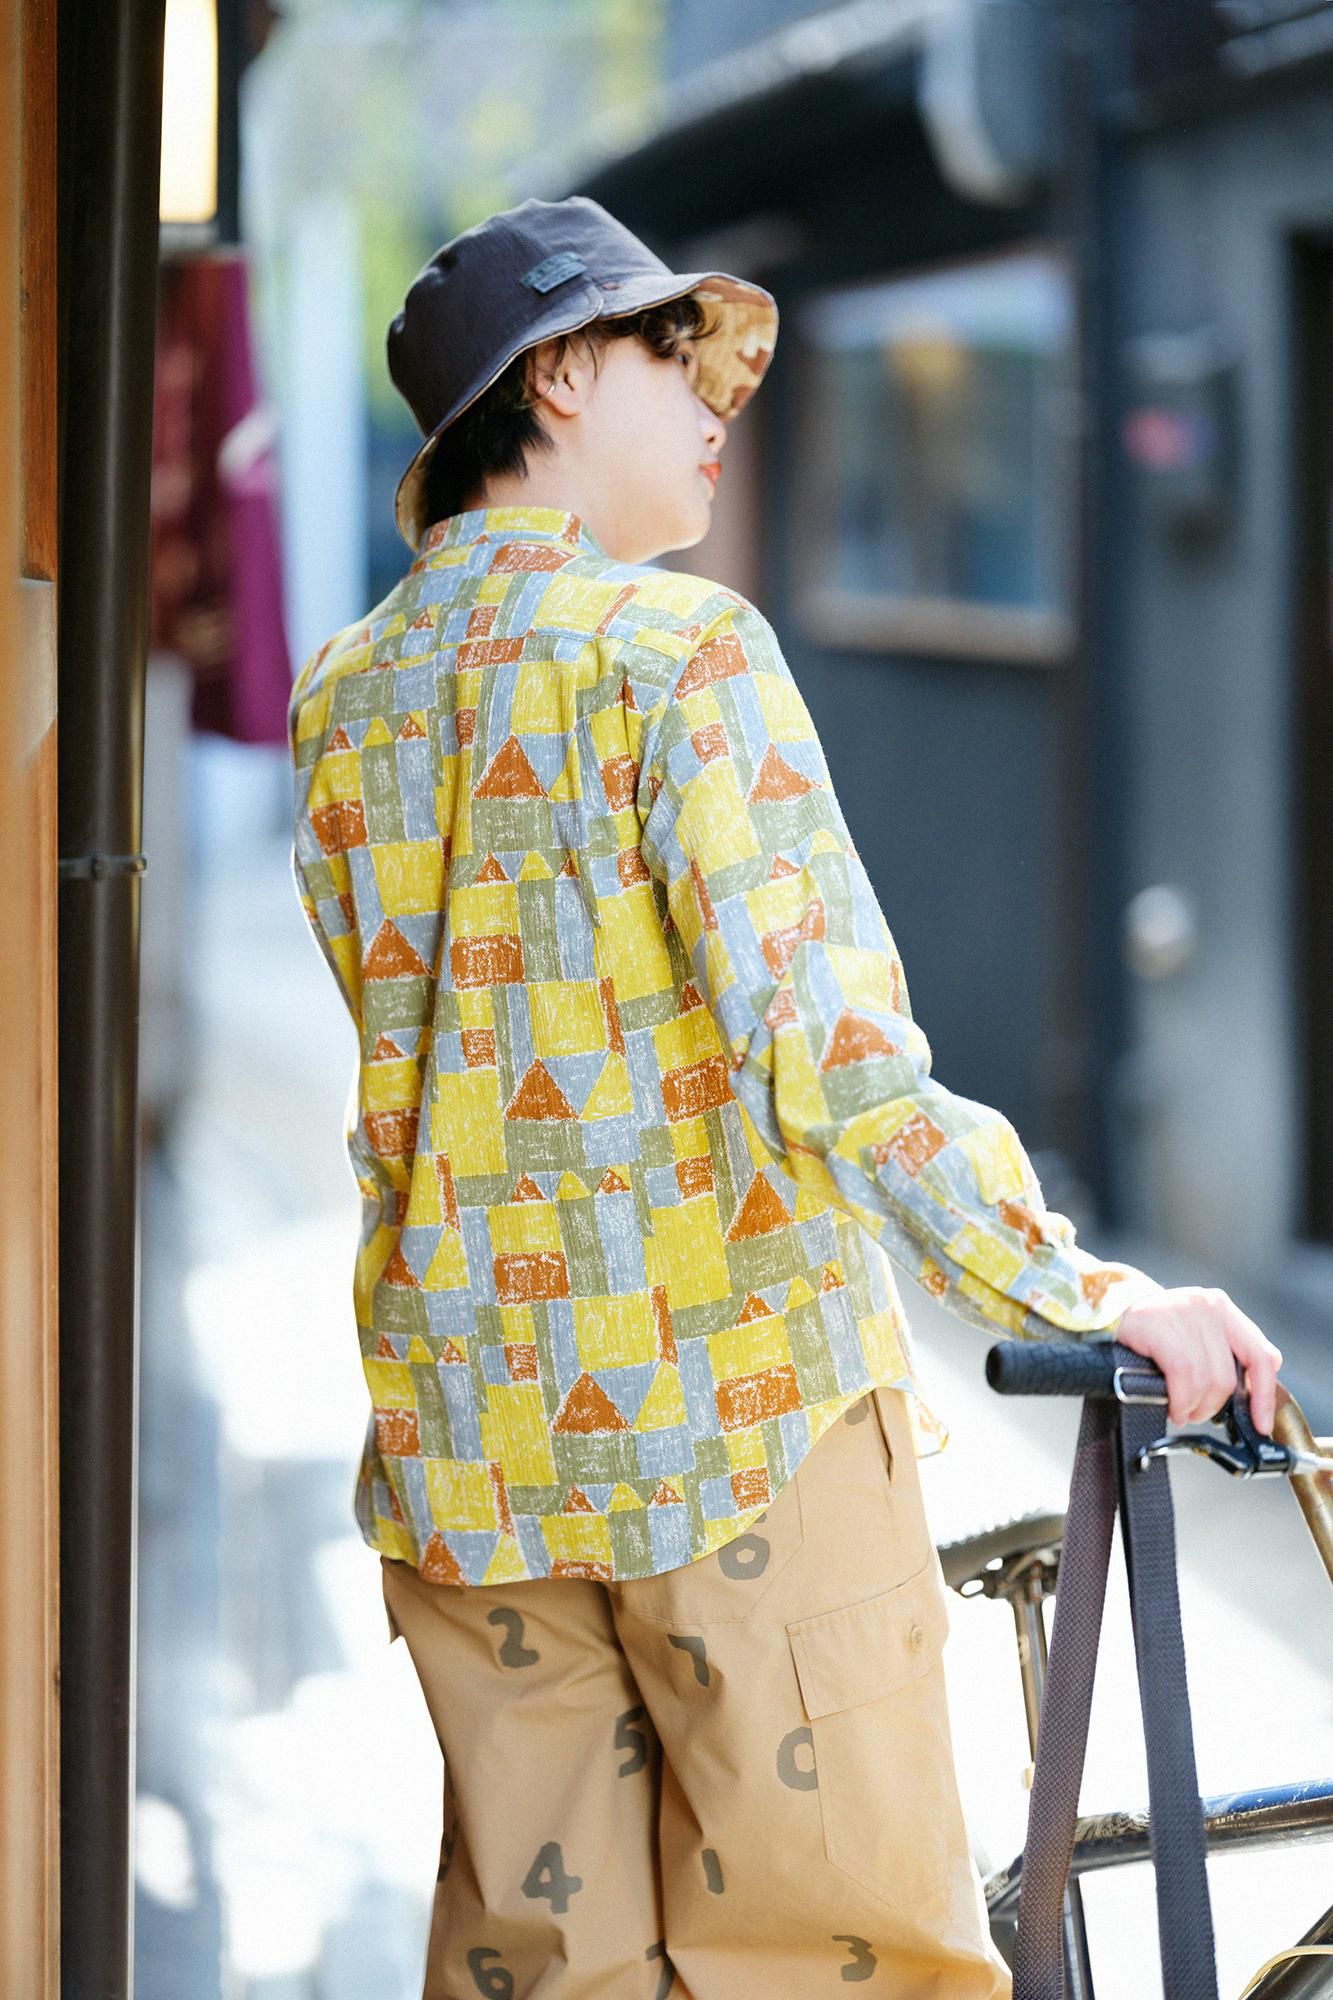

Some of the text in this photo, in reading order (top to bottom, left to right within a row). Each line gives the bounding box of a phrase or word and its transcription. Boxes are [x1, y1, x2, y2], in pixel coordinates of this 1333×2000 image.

[487, 1607, 541, 1668] 2
[615, 1704, 648, 1778] 5
[521, 1841, 582, 1914] 4
[466, 1947, 514, 2000] 6
[832, 1935, 877, 1981] 3
